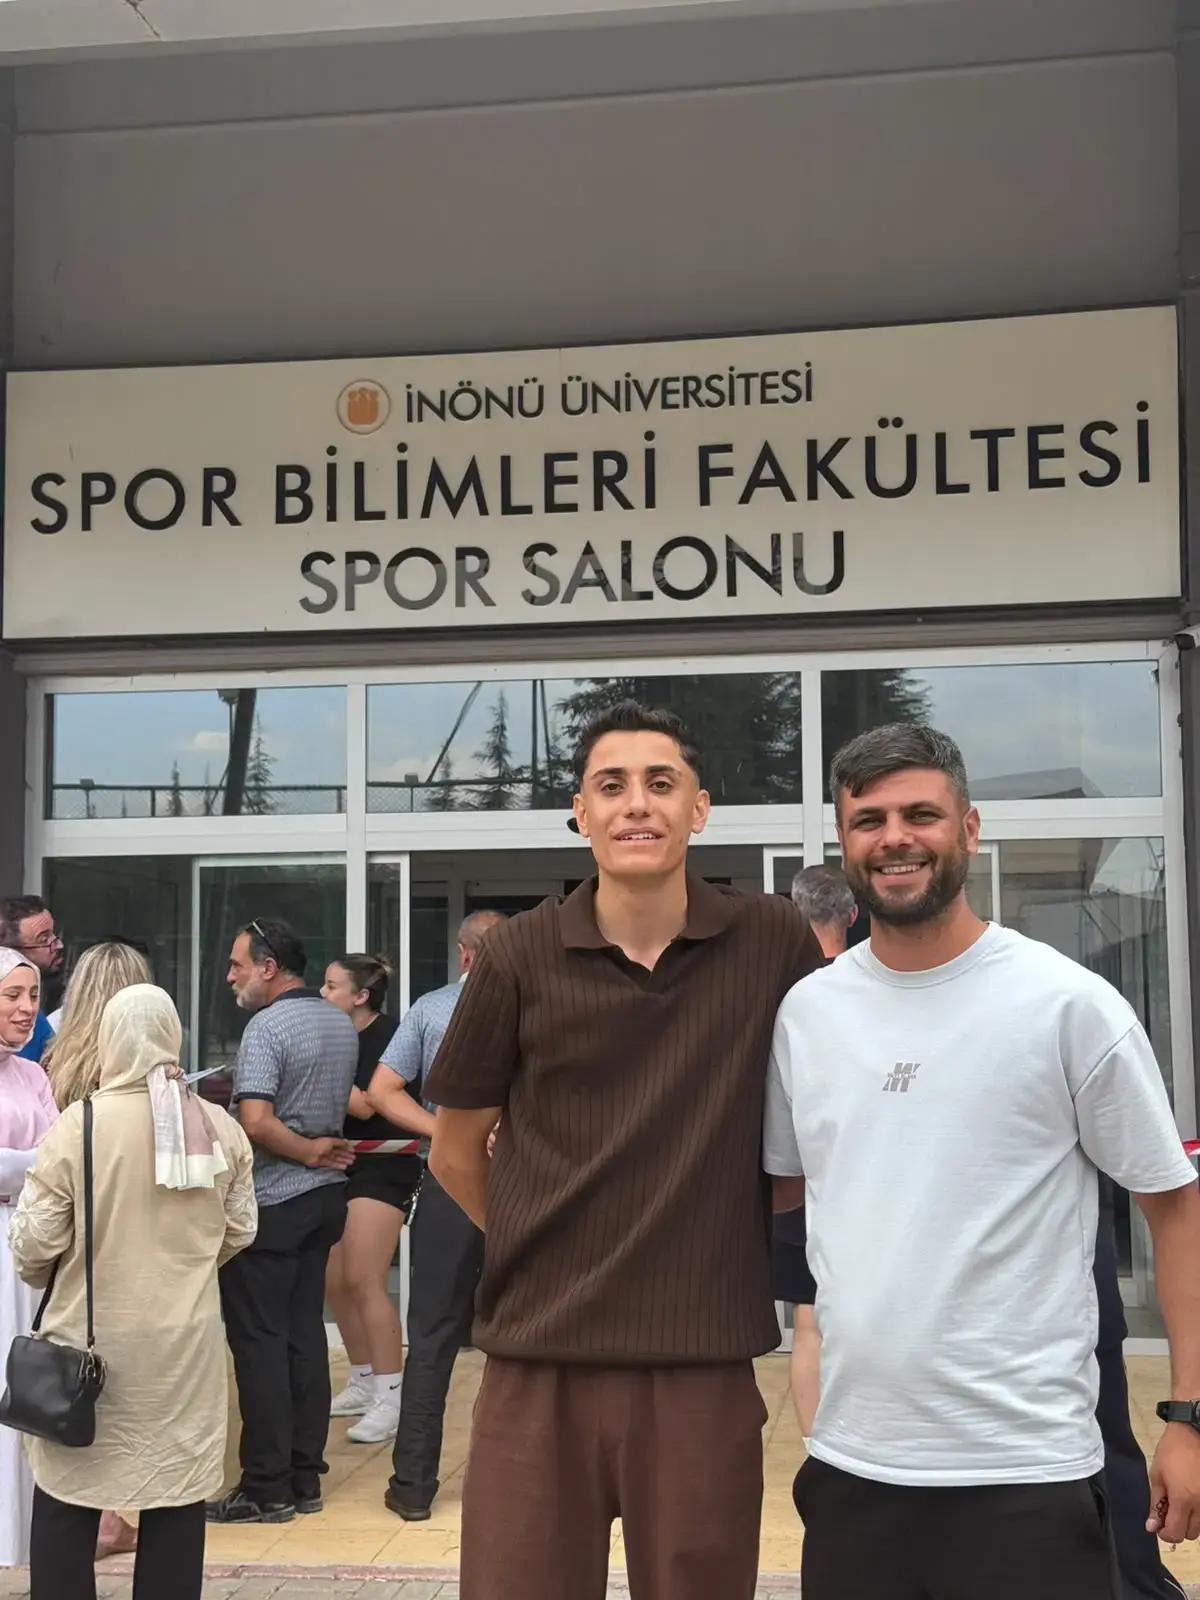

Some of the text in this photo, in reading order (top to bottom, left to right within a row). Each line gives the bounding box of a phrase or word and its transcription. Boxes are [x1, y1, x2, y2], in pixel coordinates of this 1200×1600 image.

[406, 361, 814, 424] İNÖNÜ ÜNİVERSİTESİ
[29, 400, 1151, 536] SPOR BİLİMLERİ FAKÜLTESİ
[298, 530, 846, 615] SPOR SALONU
